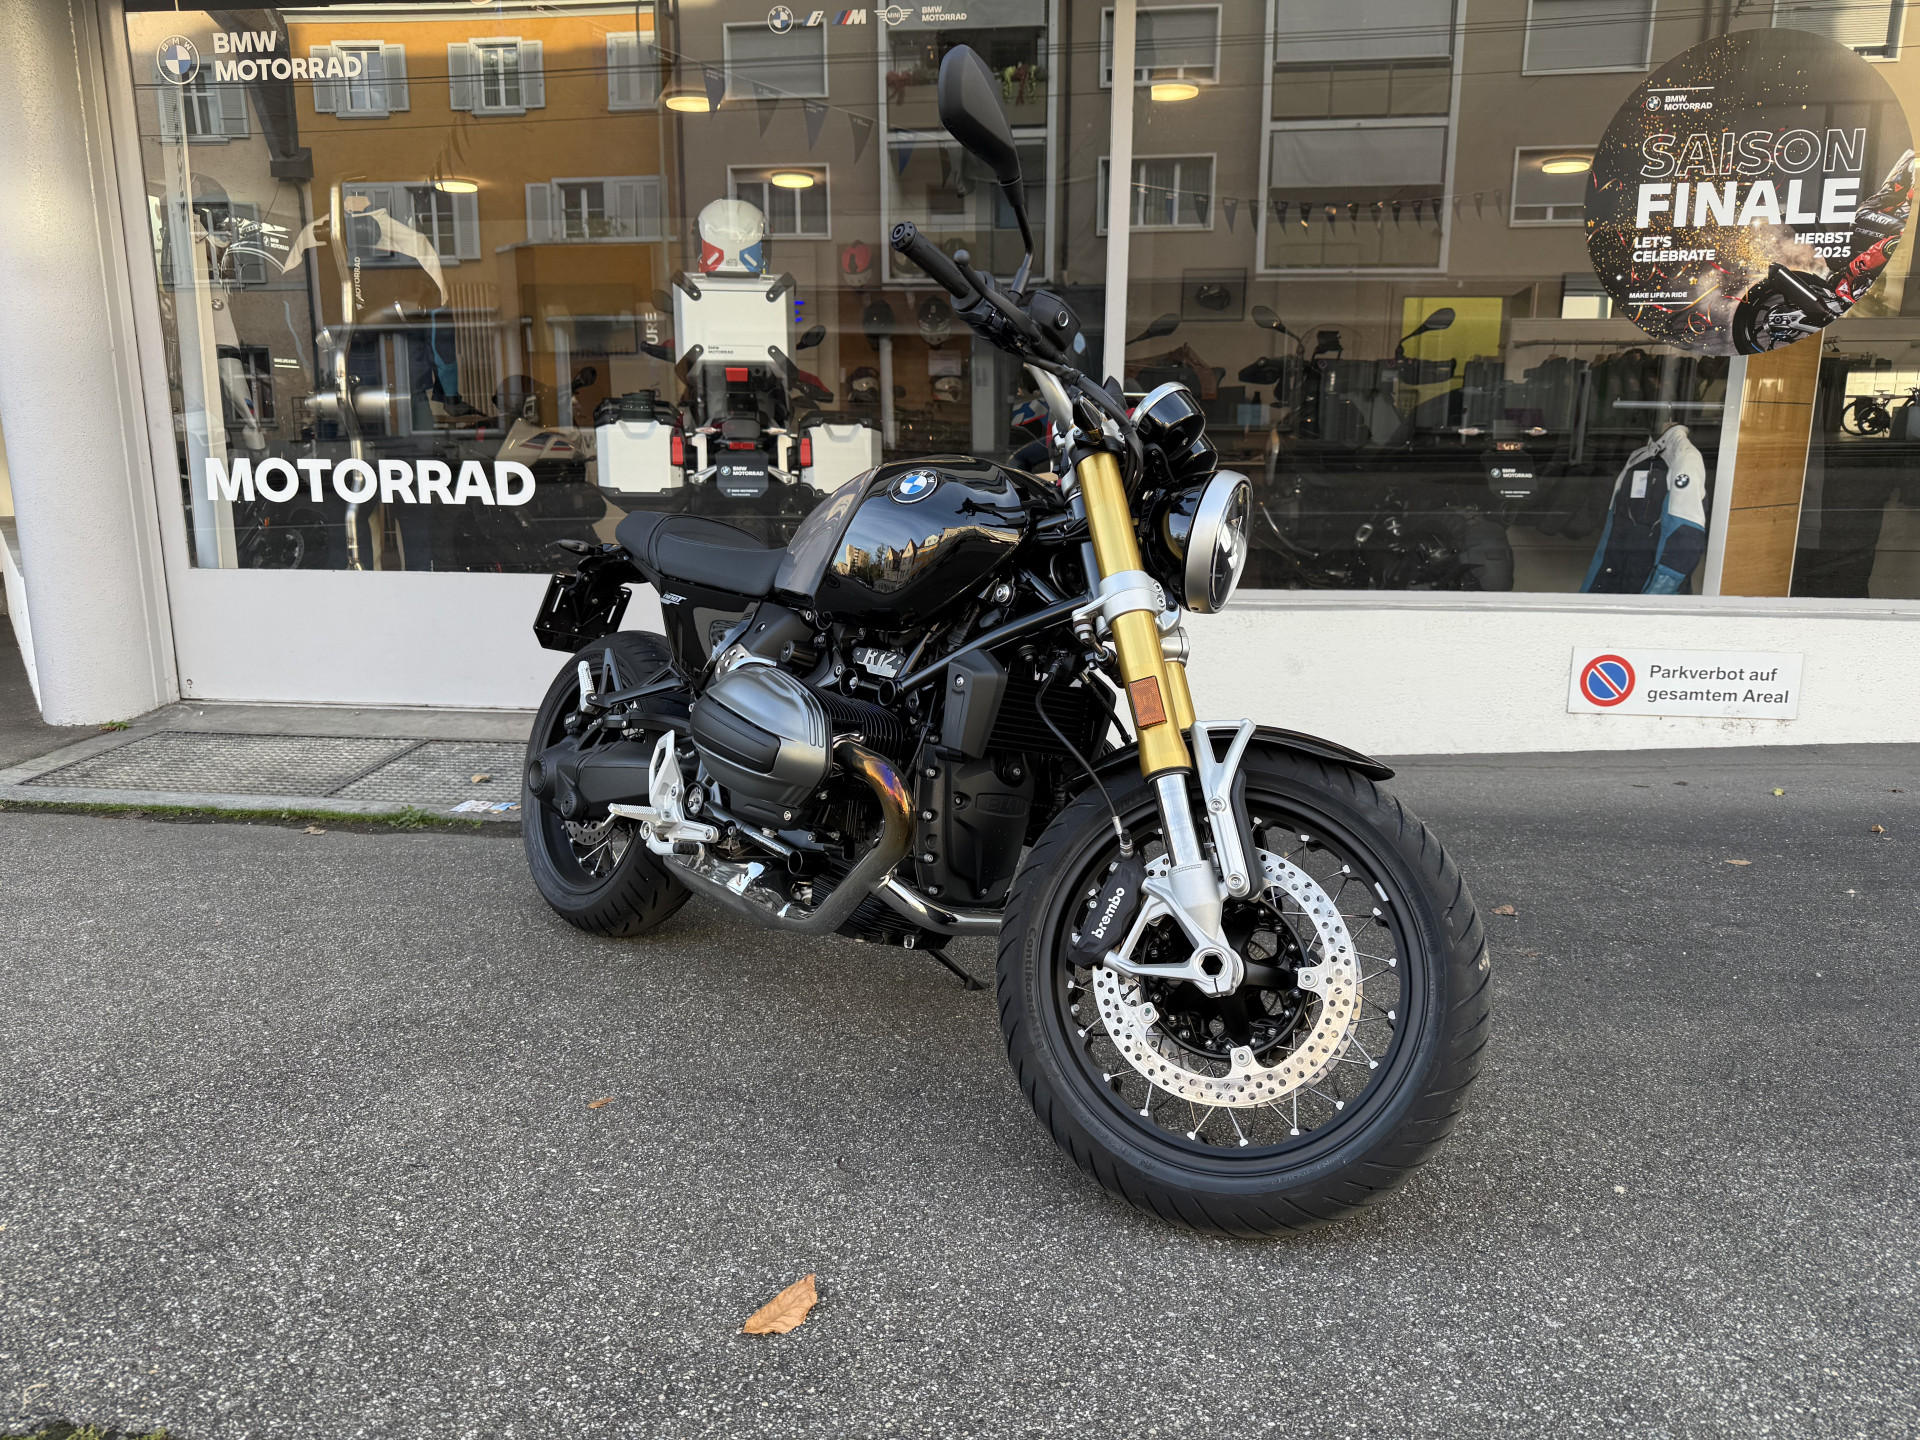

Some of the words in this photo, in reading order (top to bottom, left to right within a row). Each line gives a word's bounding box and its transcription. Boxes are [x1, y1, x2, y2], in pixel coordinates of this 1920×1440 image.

[921, 6, 942, 14] BMW
[921, 13, 967, 22] MOTORRAD
[213, 31, 277, 53] BMW
[214, 56, 363, 82] MOTORRAD
[1665, 94, 1687, 103] BMW
[1664, 102, 1713, 112] MOTORRAD
[1640, 128, 1867, 178] SAISON
[1636, 178, 1861, 228] FINALE
[1633, 236, 1672, 249] LET'S
[1794, 231, 1854, 245] HERBST
[1632, 249, 1716, 263] CELEBRATE
[1813, 246, 1851, 259] 2025
[204, 457, 536, 506] MOTORRAD
[1649, 664, 1745, 682] Parkverbot
[1749, 667, 1778, 682] auf
[1647, 688, 1738, 704] gesamtem
[1742, 688, 1790, 704] Areal
[1091, 887, 1126, 939] brembo
